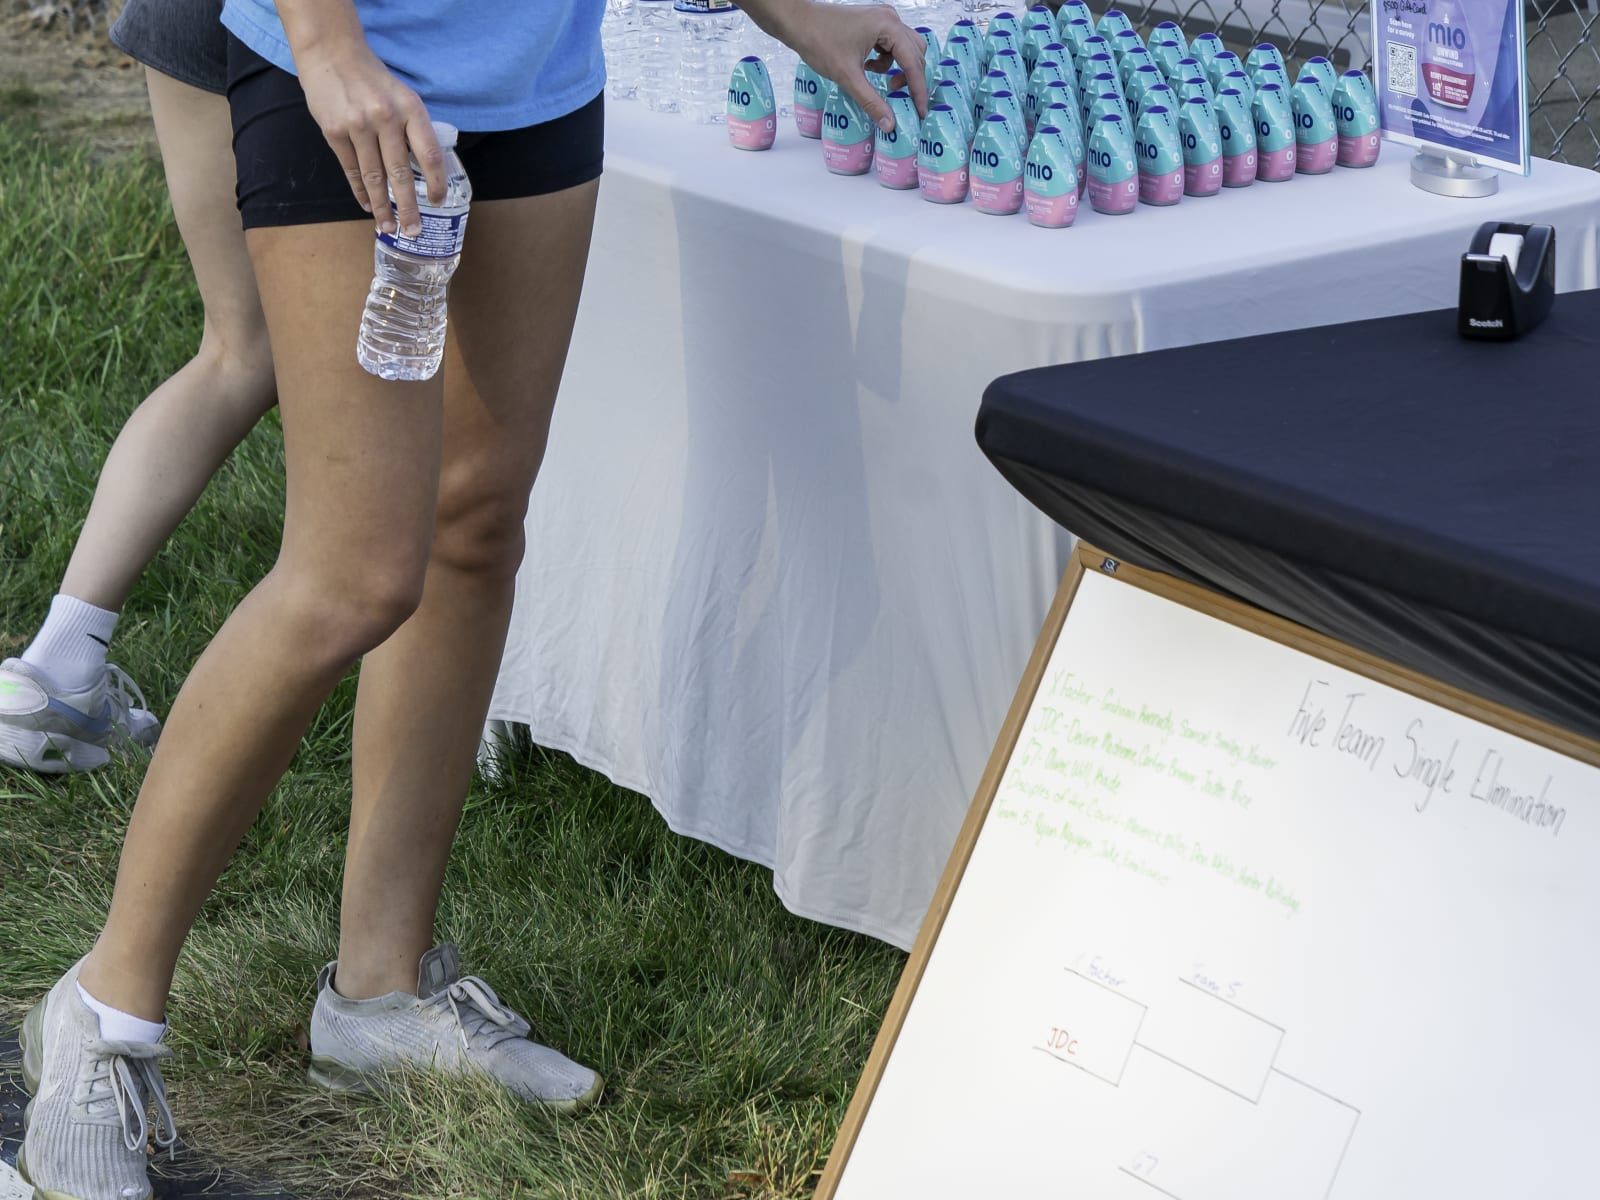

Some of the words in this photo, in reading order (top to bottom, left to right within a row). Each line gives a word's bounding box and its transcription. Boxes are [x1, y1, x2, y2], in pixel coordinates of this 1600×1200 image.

[1469, 318, 1504, 328] Scotch
[1288, 680, 1330, 748] Five
[1332, 691, 1385, 771] Team
[1393, 717, 1459, 813] Single
